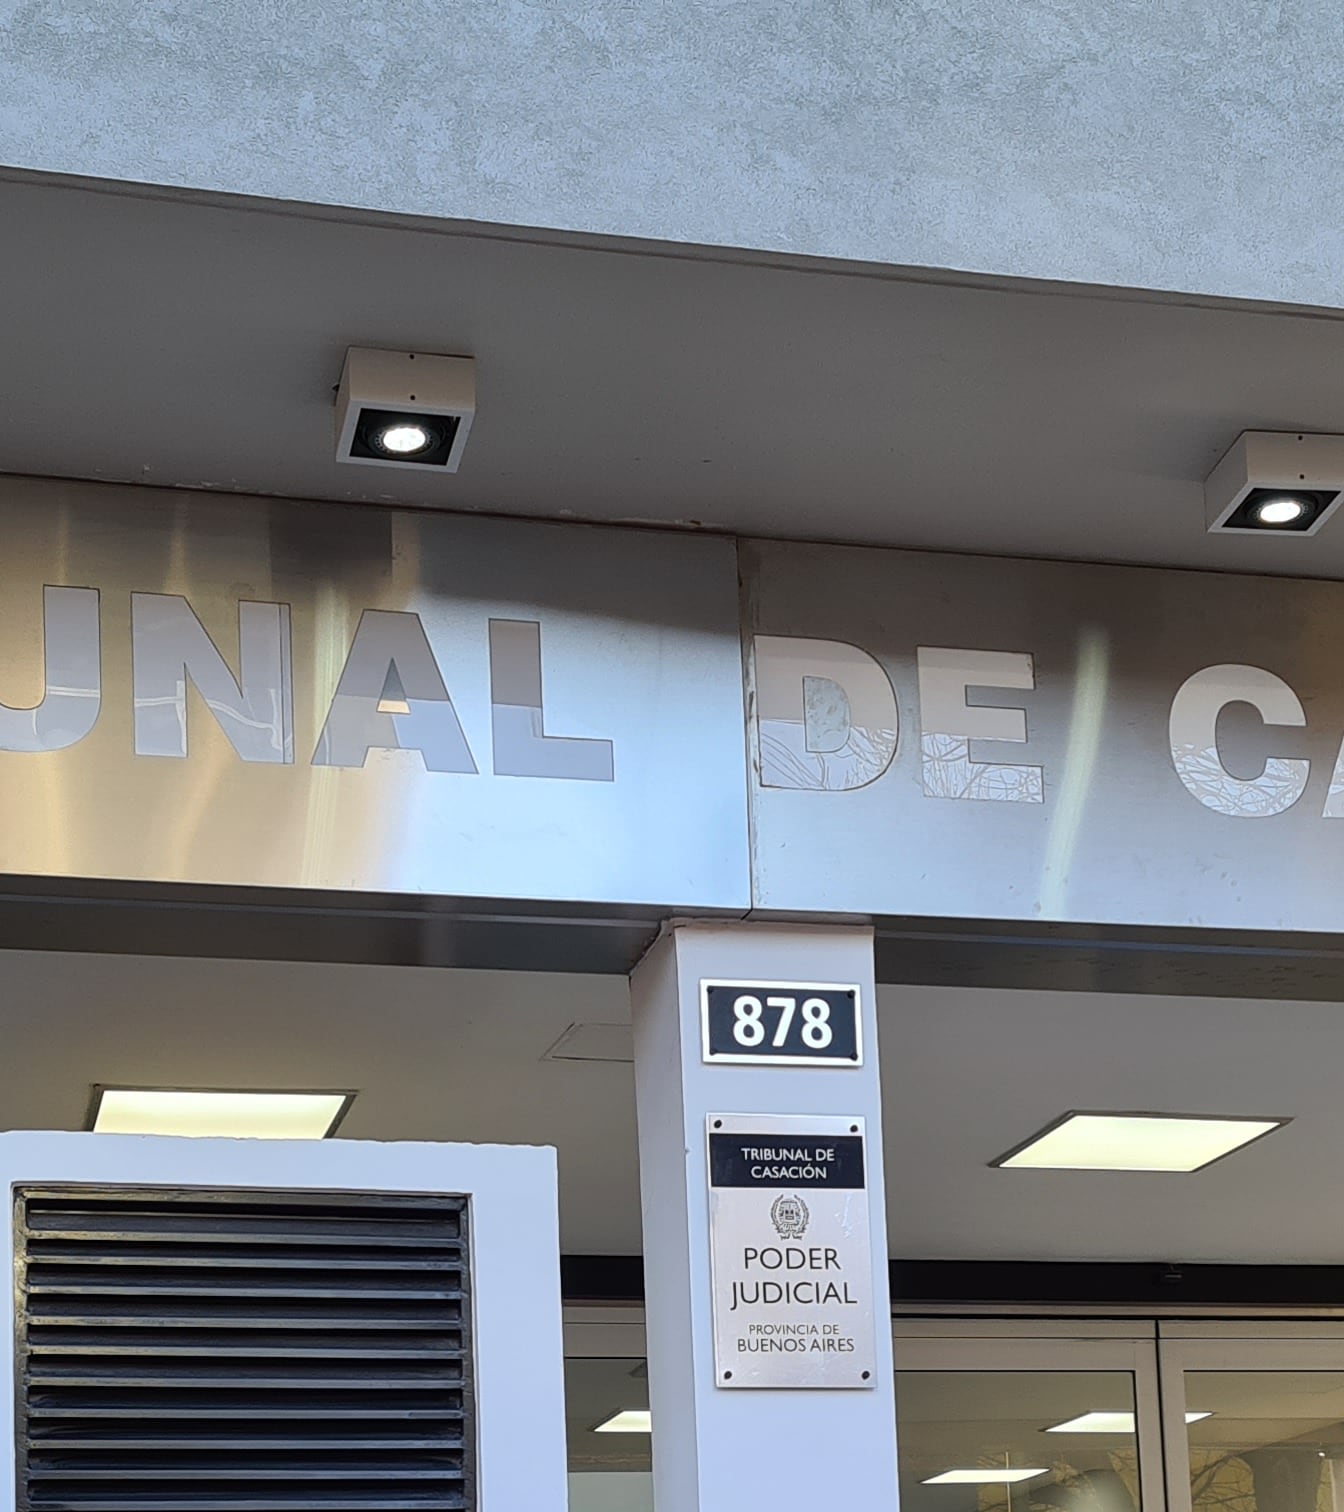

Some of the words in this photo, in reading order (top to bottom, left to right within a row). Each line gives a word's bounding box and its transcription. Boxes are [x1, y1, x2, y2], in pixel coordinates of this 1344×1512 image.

[753, 635, 1045, 804] DE
[733, 995, 833, 1049] 878
[740, 1147, 813, 1161] TRIBUNAL
[815, 1148, 836, 1162] DE
[750, 1163, 828, 1179] CASACIÓN
[743, 1247, 842, 1271] PODER
[729, 1281, 859, 1312] JUDICIAL
[748, 1324, 819, 1336] PROVINCIA
[822, 1324, 841, 1336] DE
[737, 1338, 807, 1353] BUENOS
[809, 1337, 855, 1352] AIRES
